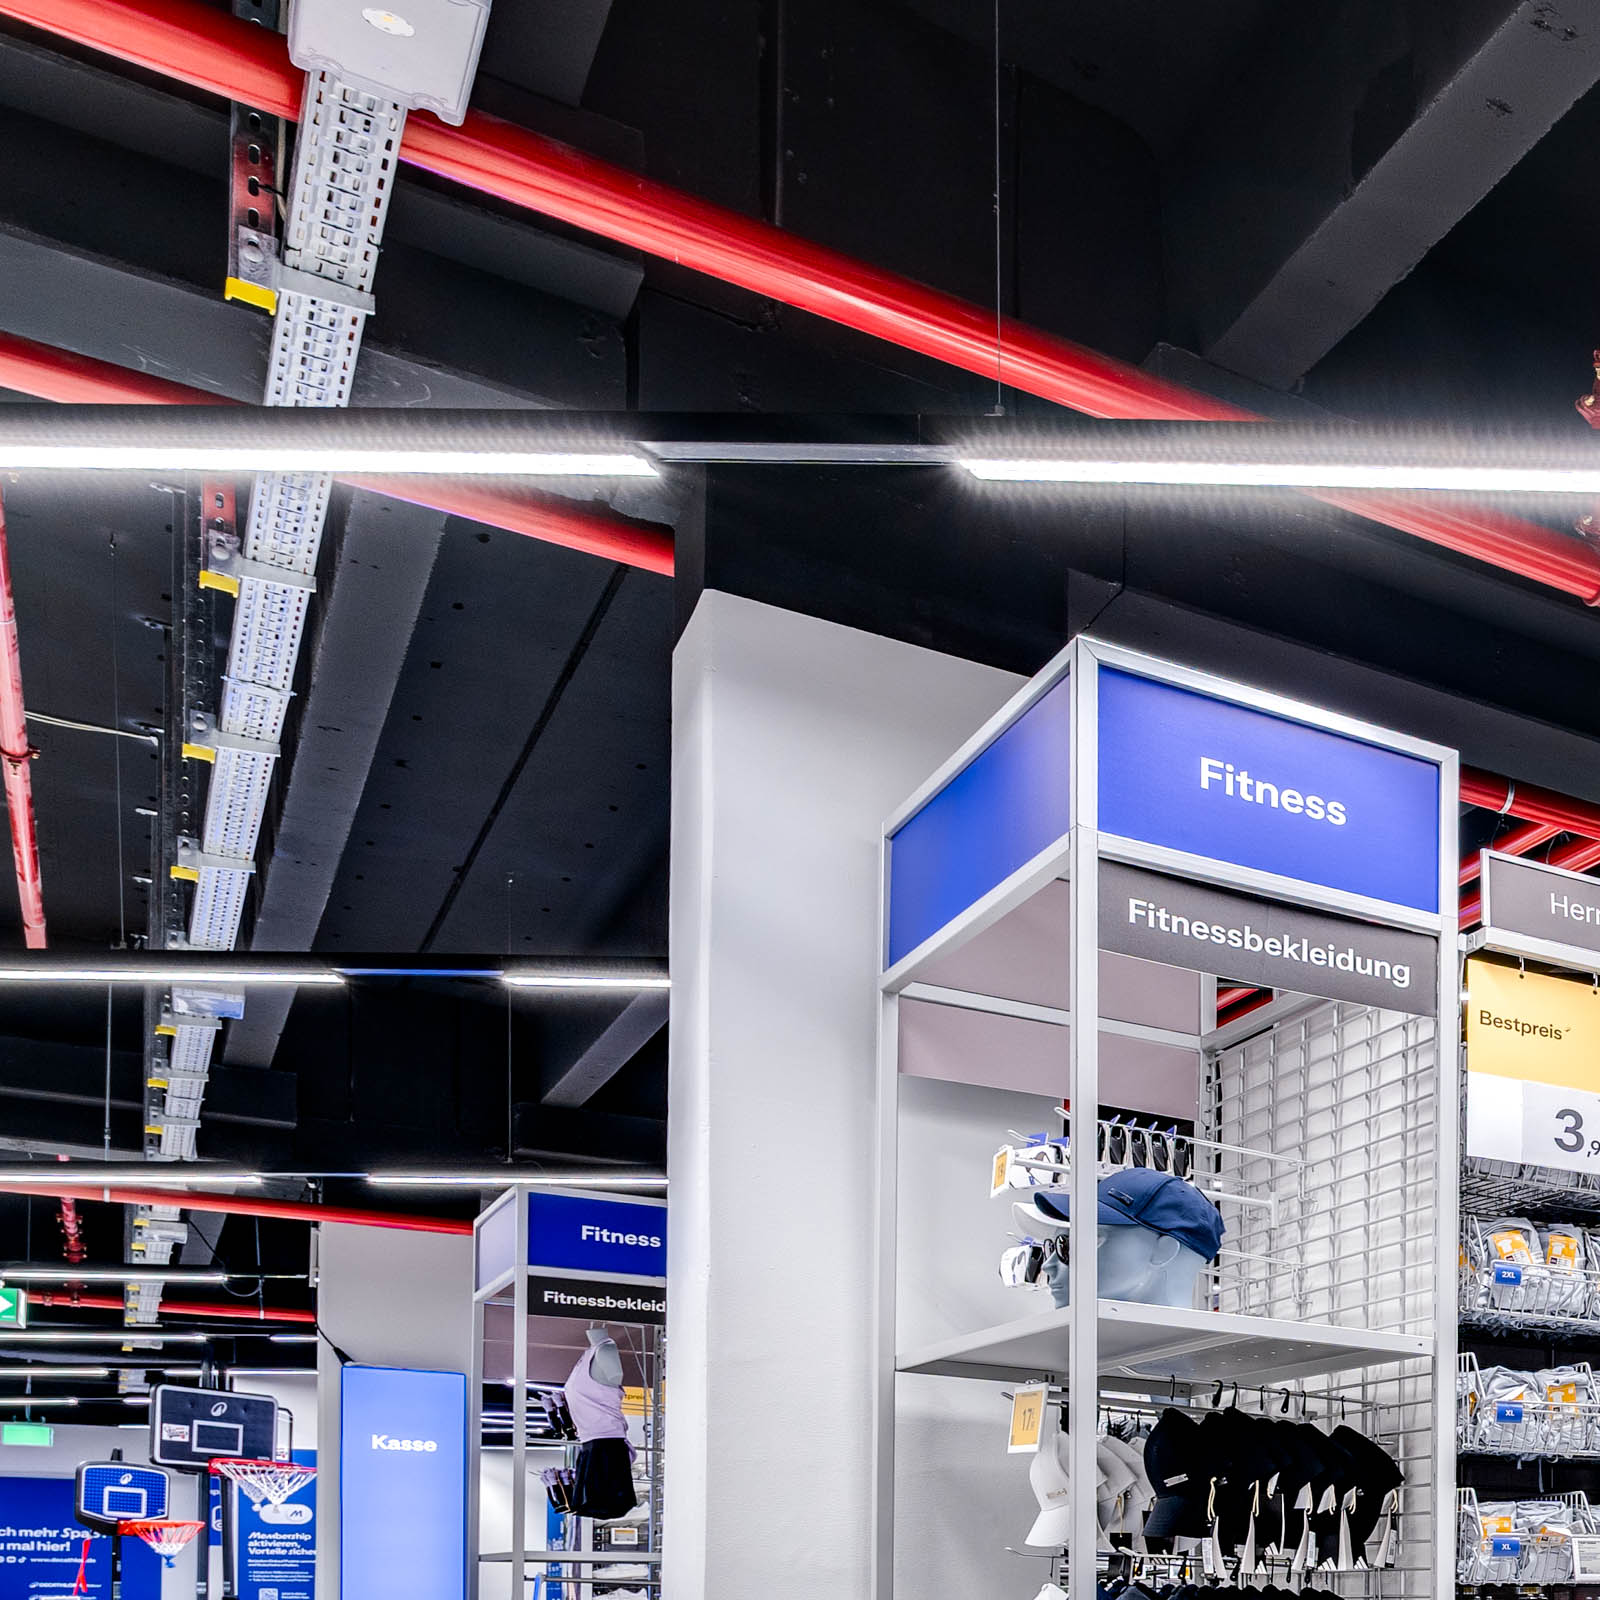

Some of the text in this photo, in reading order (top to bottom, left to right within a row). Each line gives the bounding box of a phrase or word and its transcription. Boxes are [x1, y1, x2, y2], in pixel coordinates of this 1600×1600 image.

[1199, 756, 1347, 826] Fitness
[1128, 898, 1412, 988] Fitnessbekleidung
[581, 1224, 661, 1248] Fitness
[1501, 1271, 1516, 1279] 2XL
[1505, 1409, 1515, 1417] XL
[371, 1434, 438, 1453] Kasse
[18, 1527, 60, 1538] mehr
[248, 1531, 312, 1542] Membership
[6, 1541, 35, 1551] mal
[36, 1541, 71, 1552] hier!
[1501, 1543, 1511, 1551] XL
